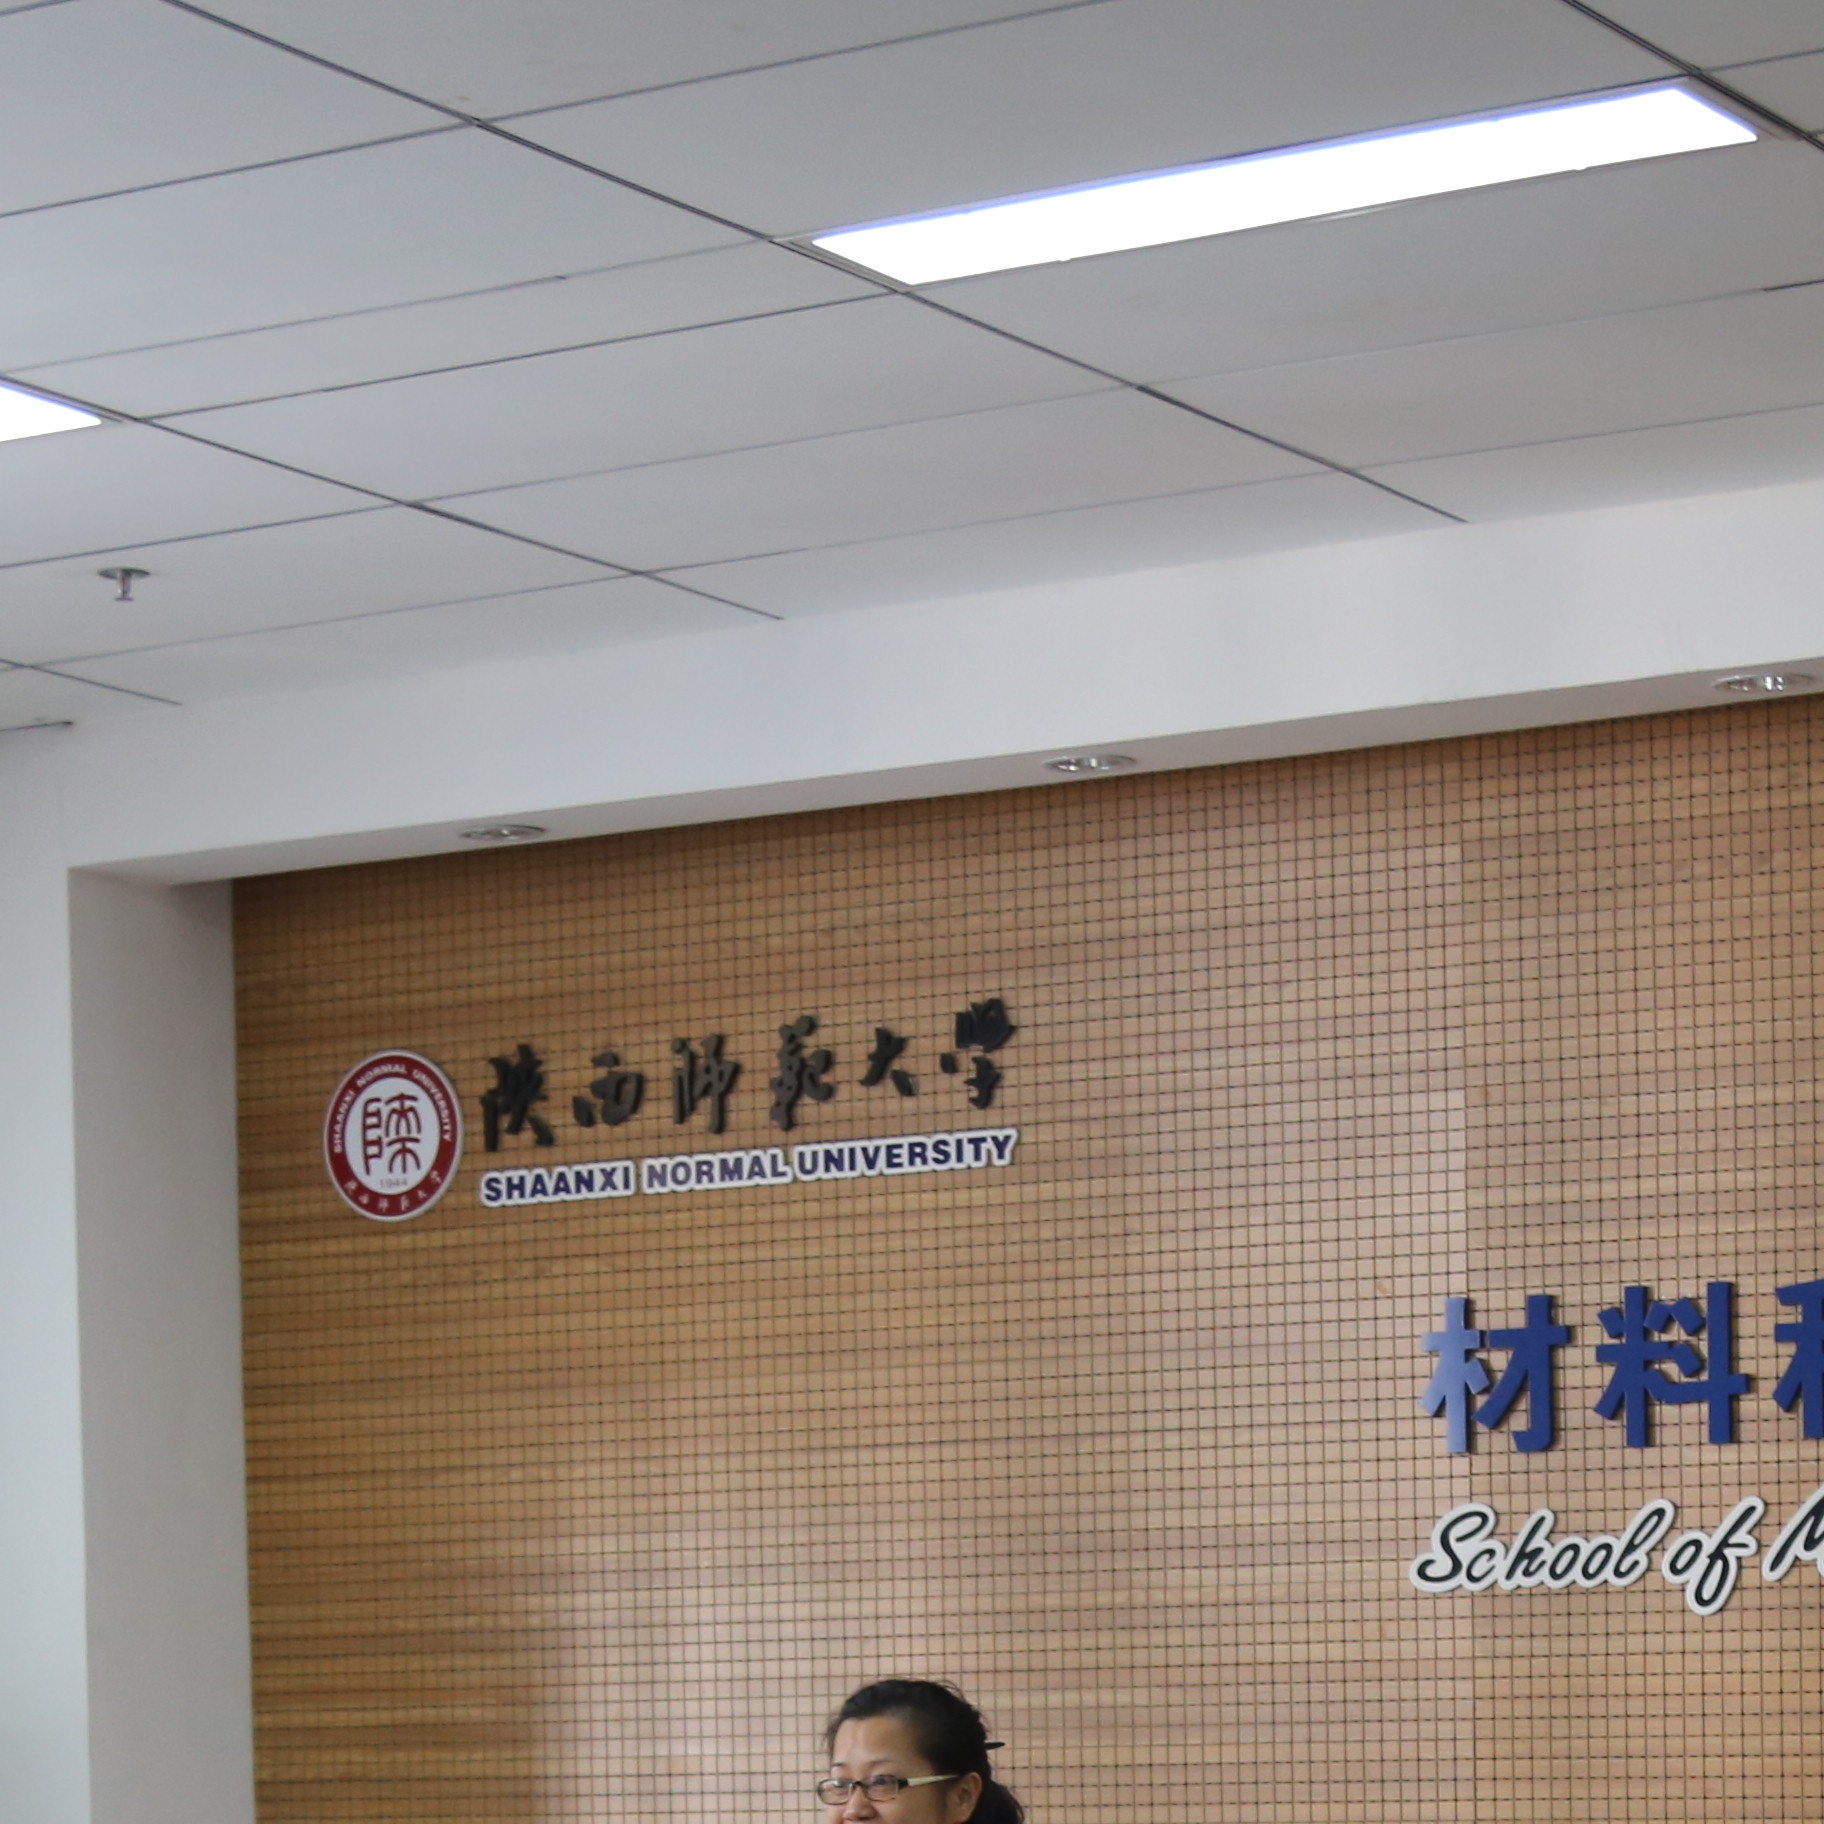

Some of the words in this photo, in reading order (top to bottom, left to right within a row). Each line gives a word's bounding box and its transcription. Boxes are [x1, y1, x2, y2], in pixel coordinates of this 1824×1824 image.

[334, 1090, 356, 1153] SHAANXI
[356, 1063, 408, 1087] NORMAL
[411, 1069, 452, 1142] UNIVERSITY
[484, 1165, 631, 1202] SHAANXI
[646, 1153, 788, 1189] NORMAL
[797, 1134, 1013, 1176] UNIVERSITY
[1415, 1505, 1668, 1586] School
[1666, 1502, 1759, 1609] of
